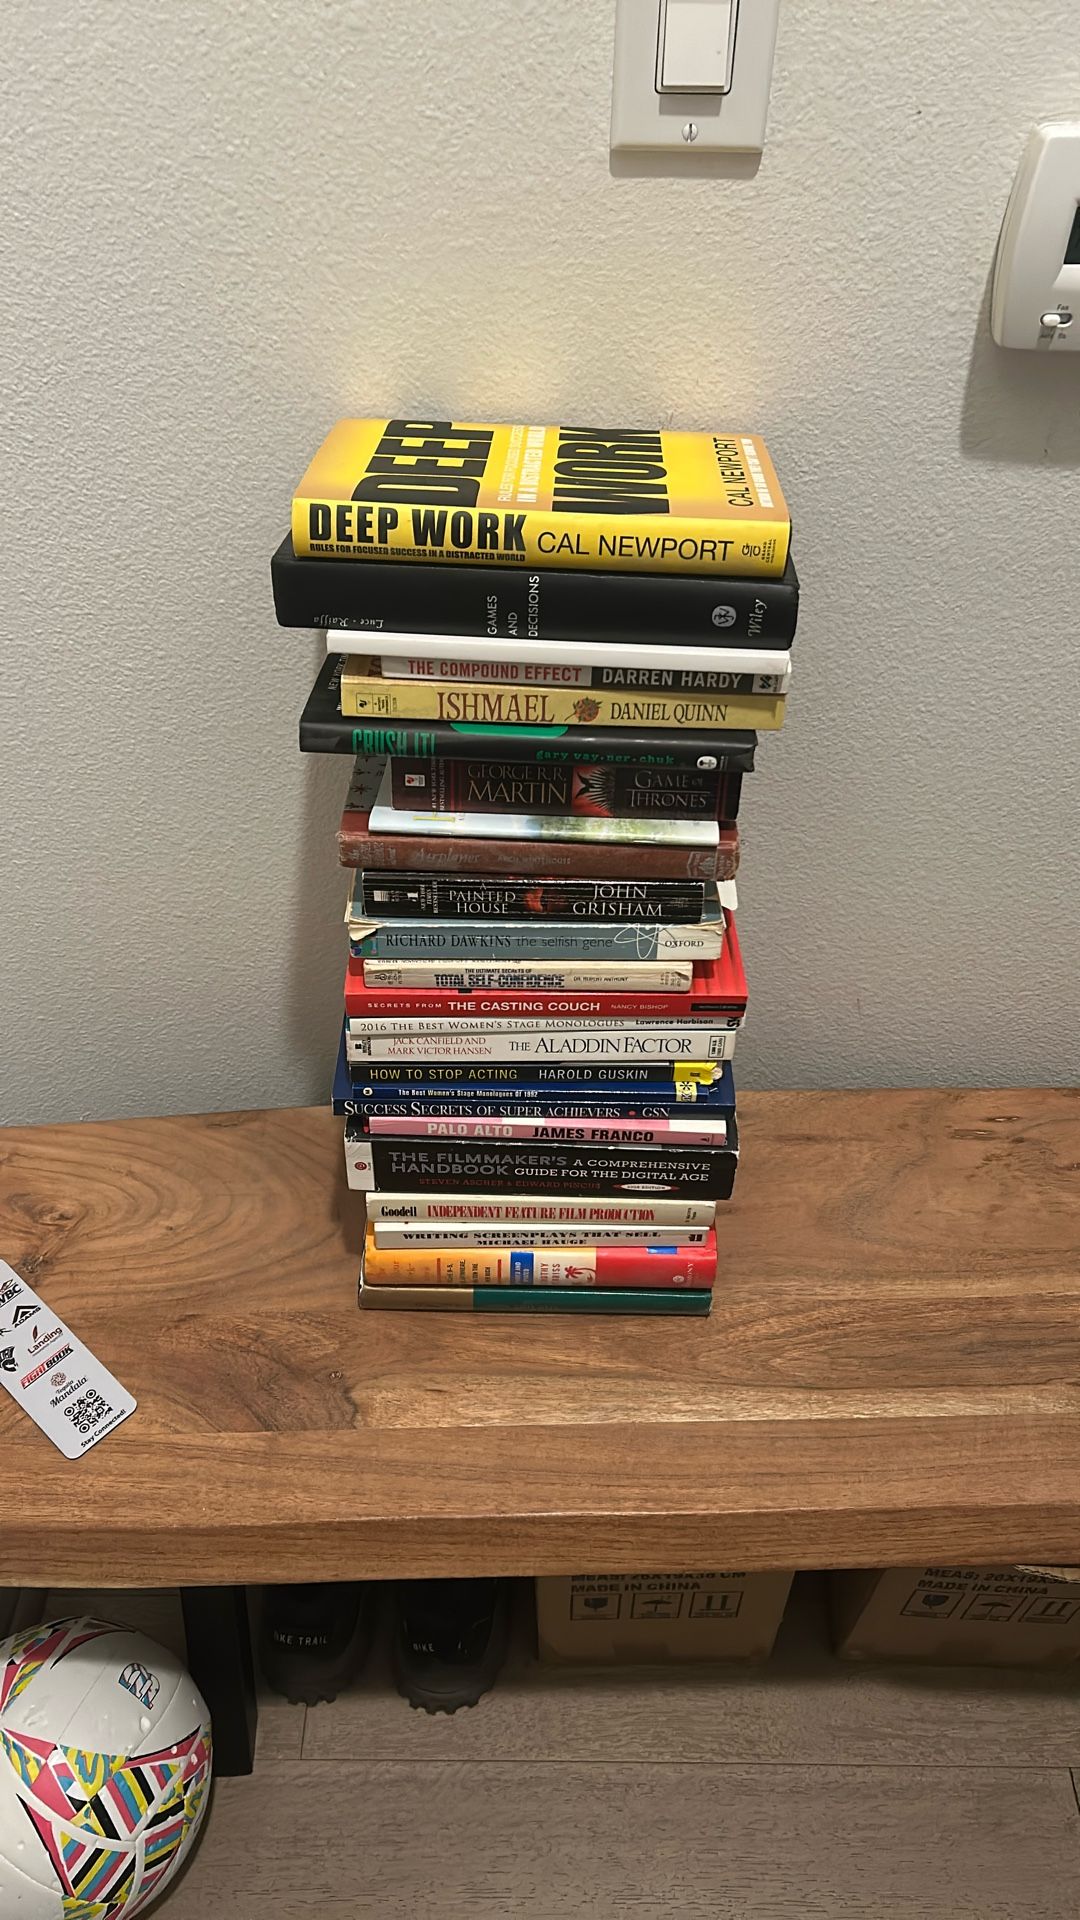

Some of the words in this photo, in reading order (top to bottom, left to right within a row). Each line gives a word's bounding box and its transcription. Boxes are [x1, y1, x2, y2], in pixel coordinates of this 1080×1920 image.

[351, 420, 494, 507] DEEP
[713, 437, 747, 484] NEWPORT
[552, 426, 670, 514] WORK
[725, 487, 754, 507] CAL
[309, 503, 399, 544] DEEP
[411, 508, 528, 551] WORK
[310, 543, 335, 553] RULES
[335, 544, 351, 554] FOR
[352, 545, 389, 556] FOCUSED
[390, 547, 428, 559] SUCCESS
[428, 549, 437, 558] IN
[438, 550, 445, 559] A
[446, 550, 495, 561] DISTRACTED
[496, 552, 525, 562] WORLD
[537, 531, 589, 555] CAL
[599, 534, 735, 561] NEWPORT
[487, 595, 498, 635] GAMES
[528, 575, 540, 638] DECISIONS
[313, 614, 349, 627] Raiffa
[360, 619, 384, 629] Luce
[507, 611, 518, 636] AND
[748, 599, 768, 637] Wiley
[408, 660, 434, 676] THE
[440, 662, 519, 680] COMPOUND
[525, 665, 582, 682] EFFECT
[602, 669, 673, 687] DARREN
[681, 672, 743, 689] HARDY
[437, 692, 555, 723] ISHMAEL
[610, 702, 670, 721] DANIEL
[673, 703, 728, 724] QUINN
[352, 729, 408, 756] CRUSH
[414, 732, 436, 757] IT!
[536, 750, 569, 762] gary
[468, 764, 536, 780] GEORGE
[538, 767, 567, 781] R.R.
[634, 769, 688, 788] GAME
[468, 780, 567, 804] MARTIN
[631, 790, 706, 808] THRONES
[450, 890, 516, 902] PAINTED
[594, 884, 647, 900] JOHN
[457, 903, 509, 914] HOUSE
[573, 902, 663, 917] GRISHAM
[386, 935, 446, 947] RICHARD
[451, 935, 511, 947] DAWKINS
[516, 938, 537, 947] the
[542, 935, 578, 947] selfish
[583, 938, 612, 950] gene
[664, 940, 704, 948] OXFORD
[434, 974, 467, 988] TOTAL
[468, 974, 565, 988] SELF-CONFIDENCE
[448, 1001, 476, 1011] THE
[480, 1002, 543, 1011] CASTING
[548, 1002, 600, 1011] COUCH
[361, 1023, 387, 1032] 2016
[390, 1022, 414, 1031] THE
[418, 1022, 444, 1031] BEST
[448, 1021, 502, 1030] WOMEN'S
[506, 1020, 540, 1029] STAGE
[545, 1019, 625, 1028] MONOLOGUES
[635, 1018, 674, 1026] Lawrence
[676, 1017, 714, 1026] Harbison
[393, 1037, 414, 1046] JACK
[416, 1037, 463, 1046] CANFIELD
[464, 1036, 486, 1045] AND
[509, 1041, 530, 1052] THE
[535, 1036, 621, 1054] ALADDIN
[624, 1036, 692, 1053] FACTOR
[388, 1047, 417, 1056] MARK
[418, 1047, 452, 1056] VICTOR
[453, 1046, 492, 1056] HANSEN
[370, 1069, 400, 1080] HOW
[406, 1069, 423, 1080] TO
[428, 1069, 463, 1080] STOP
[469, 1069, 518, 1080] ACTING
[539, 1069, 592, 1080] HAROLD
[598, 1069, 649, 1080] GUSKIN
[411, 1089, 426, 1097] Best
[457, 1090, 474, 1098] Stage
[476, 1090, 513, 1098] Monologues
[344, 1101, 407, 1116] SUCCESS
[410, 1102, 472, 1116] SECRETS
[477, 1105, 495, 1116] OF
[499, 1106, 542, 1117] SUPER
[546, 1107, 621, 1118] ACHIEVERS
[427, 1123, 467, 1135] PALO
[474, 1125, 513, 1137] ALTO
[532, 1127, 585, 1139] JAMES
[591, 1129, 654, 1142] FRANCO
[388, 1151, 428, 1162] THE
[437, 1152, 567, 1166] FILMMAKER'S
[573, 1159, 583, 1167] A
[587, 1159, 711, 1171] COMPREHENSIVE
[391, 1163, 509, 1175] HANDBOOK
[514, 1168, 558, 1177] GUIDE
[562, 1169, 588, 1178] FOR
[591, 1170, 618, 1179] THE
[622, 1171, 676, 1181] DIGITAL
[679, 1173, 709, 1182] AGE
[515, 1180, 560, 1188] EDWARD
[381, 1206, 417, 1217] Goodell
[427, 1205, 502, 1219] INDEPENDENT
[505, 1206, 556, 1219] FEATURE
[559, 1207, 586, 1220] FILM
[589, 1208, 655, 1221] PRODUCTION
[14, 1306, 41, 1328] ADAMS
[28, 1327, 62, 1354] Landing
[50, 1377, 88, 1408] Mandala
[56, 1379, 74, 1395] Tequila
[81, 1435, 95, 1448] Stay
[94, 1409, 127, 1436] Connected!
[923, 1568, 980, 1580] MEAS:
[571, 1584, 620, 1593] MADE
[624, 1583, 642, 1592] IN
[647, 1582, 701, 1592] CHINA
[917, 1580, 969, 1592] MADE
[972, 1583, 990, 1593] IN
[994, 1585, 1048, 1595] CHINA
[299, 1636, 328, 1646] TRAIL
